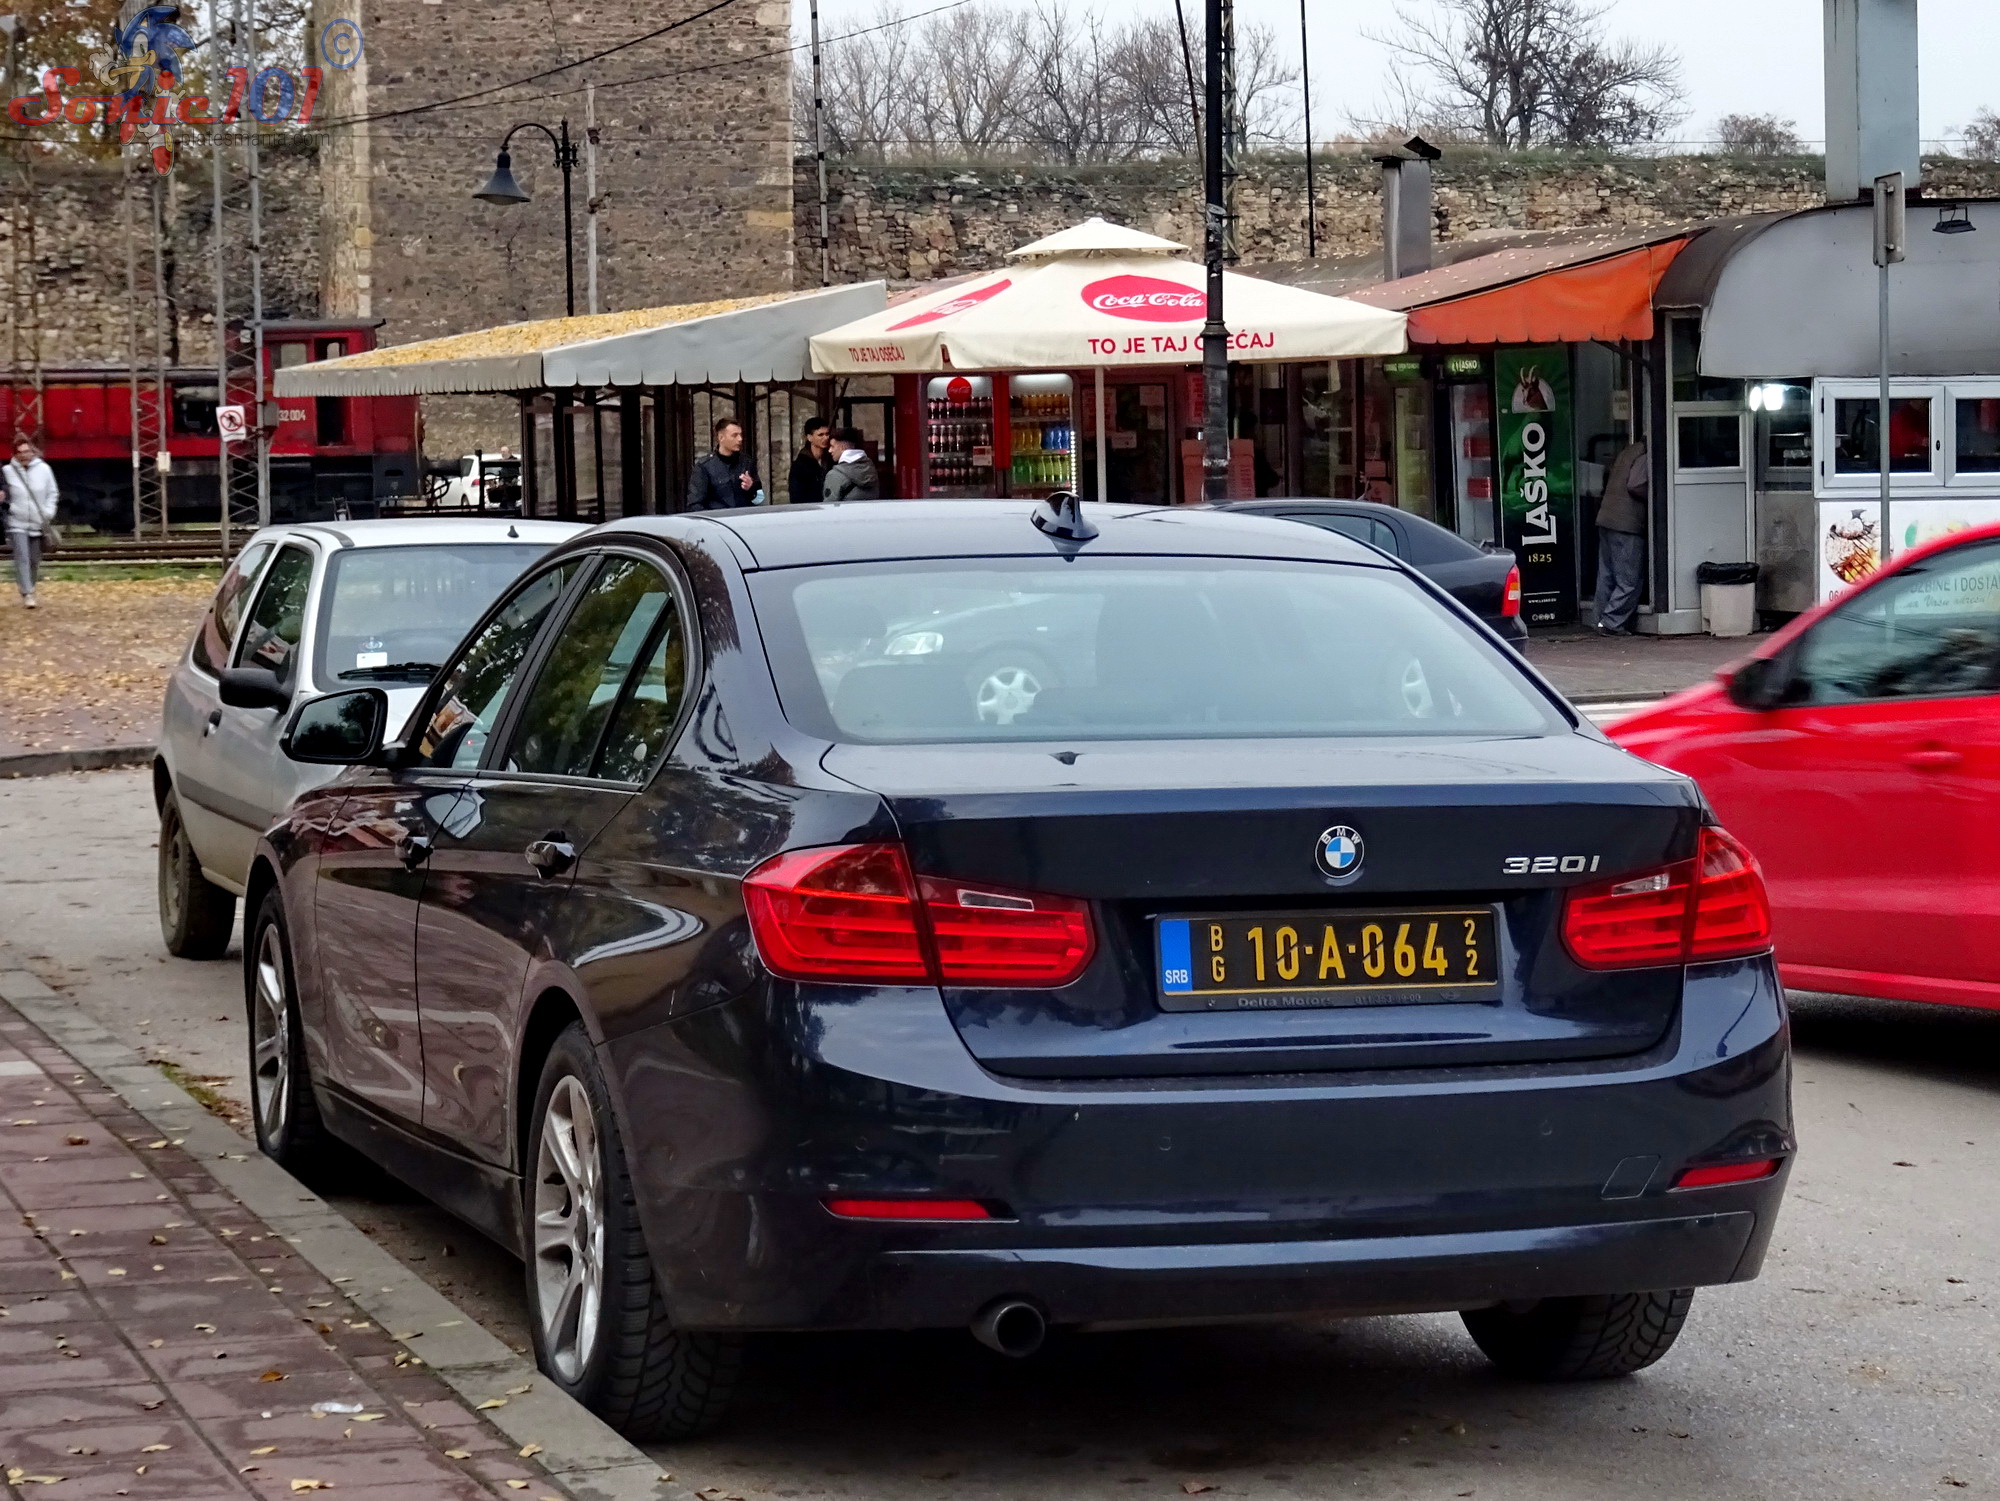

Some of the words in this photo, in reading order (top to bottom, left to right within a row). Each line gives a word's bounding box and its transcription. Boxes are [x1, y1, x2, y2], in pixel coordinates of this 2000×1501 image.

[1093, 292, 1204, 309] Coca-Cola
[1087, 337, 1116, 354] TO
[1122, 337, 1146, 353] JE
[1151, 336, 1188, 352] TAJ
[1193, 329, 1275, 351] OEĆAJ
[1520, 422, 1557, 546] LAŠKO
[1528, 553, 1552, 563] 1825
[1961, 574, 2000, 592] DOSTA
[1320, 827, 1361, 845] BMW
[1165, 969, 1189, 984] SRB
[1237, 997, 1278, 1008] Delta
